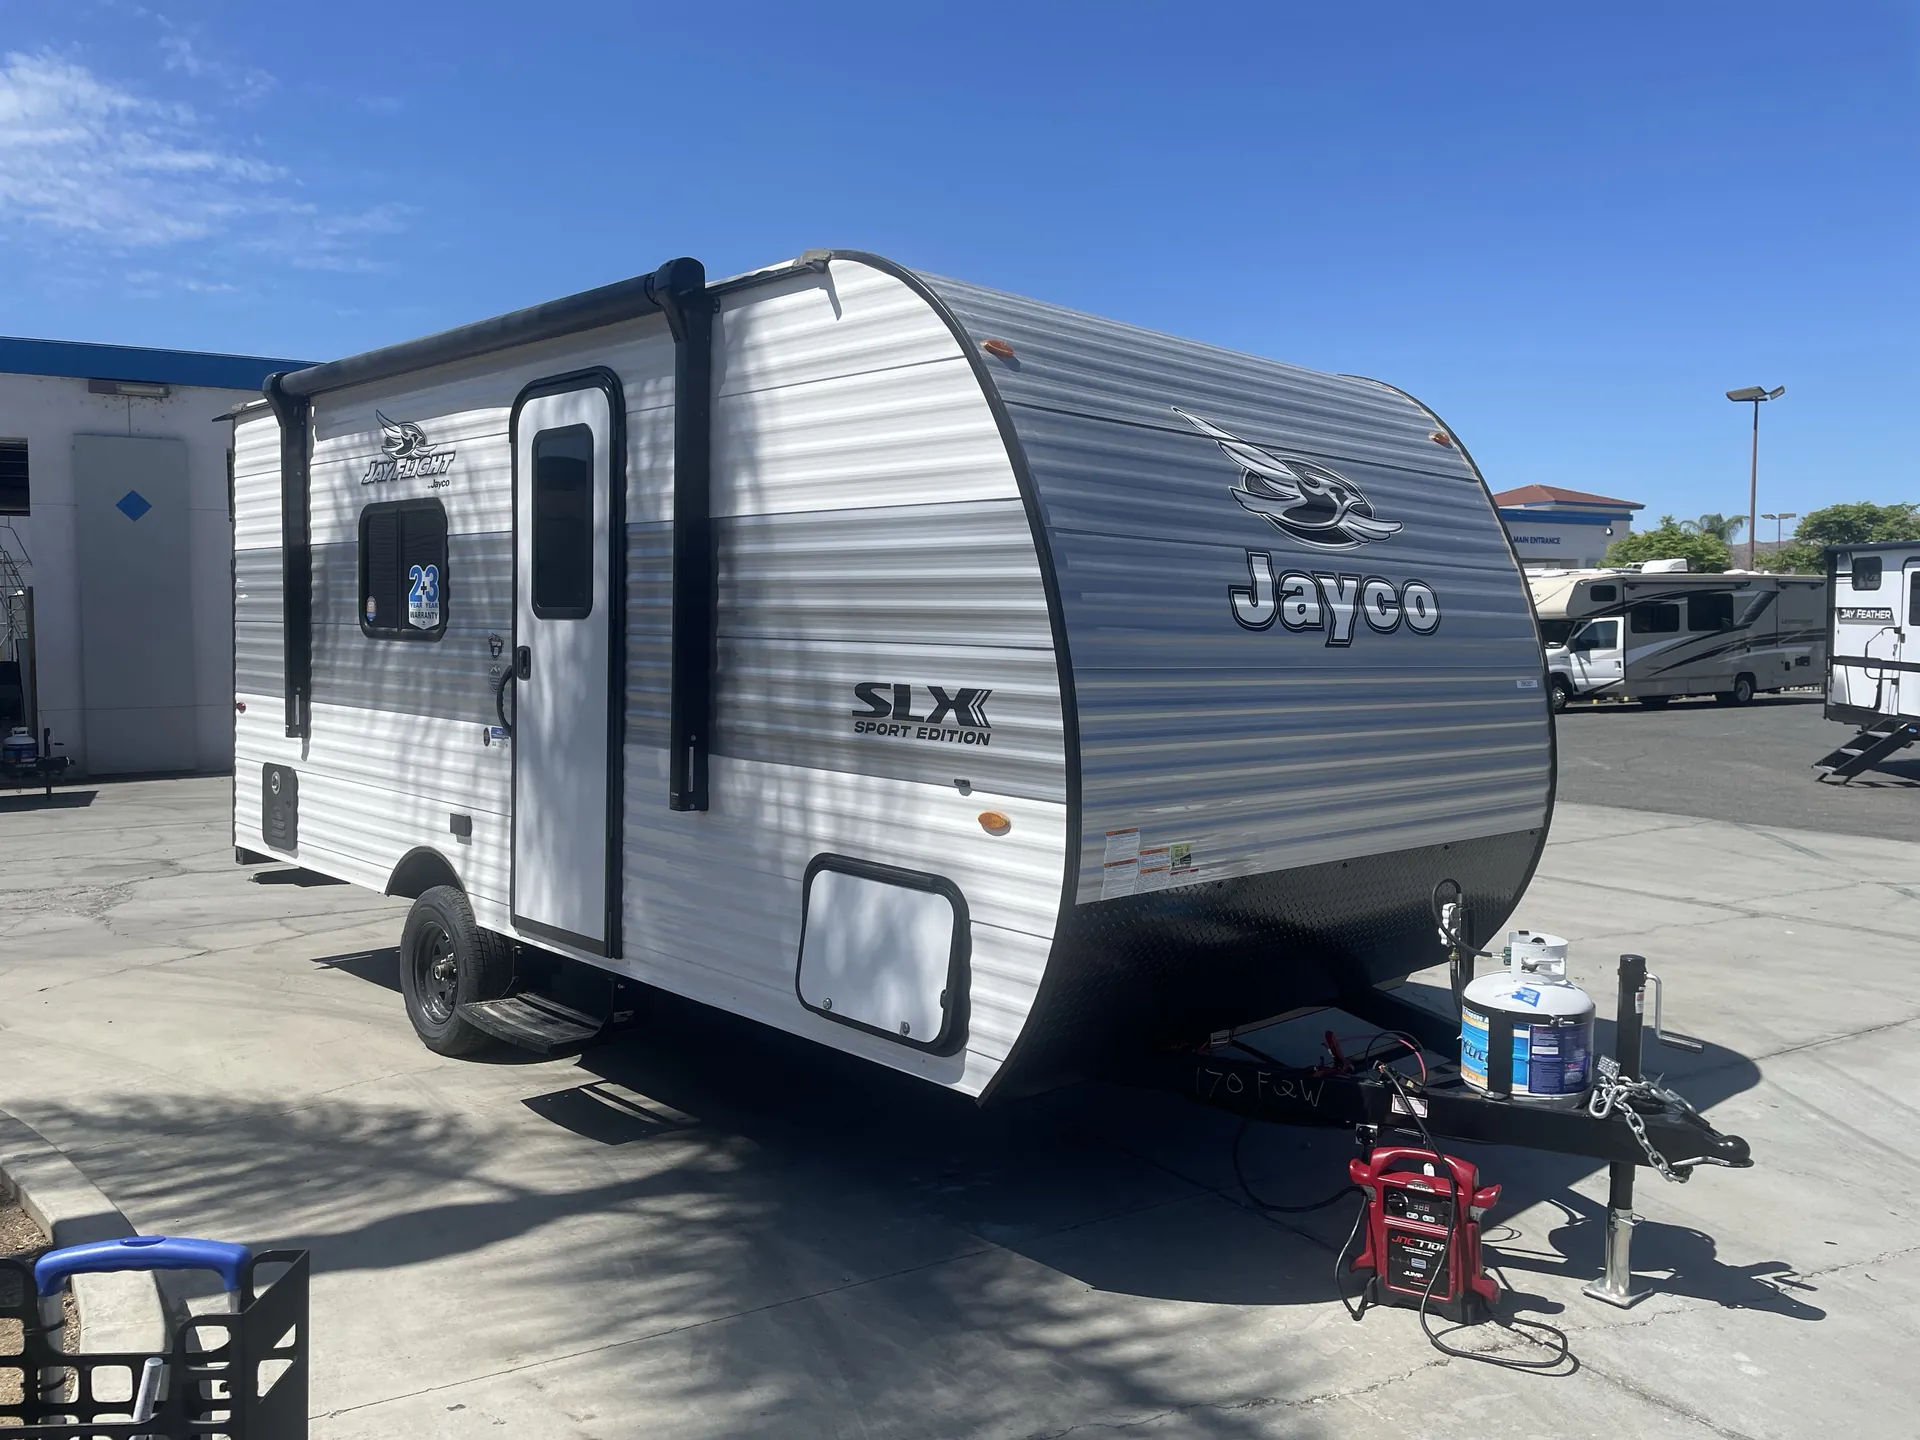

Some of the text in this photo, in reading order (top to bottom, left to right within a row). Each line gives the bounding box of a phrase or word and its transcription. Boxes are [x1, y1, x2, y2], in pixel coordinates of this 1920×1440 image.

[361, 451, 456, 485] JAY FLIGHT
[430, 479, 450, 489] Jayco
[1512, 536, 1561, 545] MAIN ENTRANCE
[1228, 548, 1441, 648] Jayco
[410, 611, 438, 619] WARRANTY
[1841, 609, 1891, 619] JAY FEATHER
[852, 682, 993, 729] SLX
[854, 721, 991, 746] SPORT EDITION
[1197, 1066, 1244, 1098] 170
